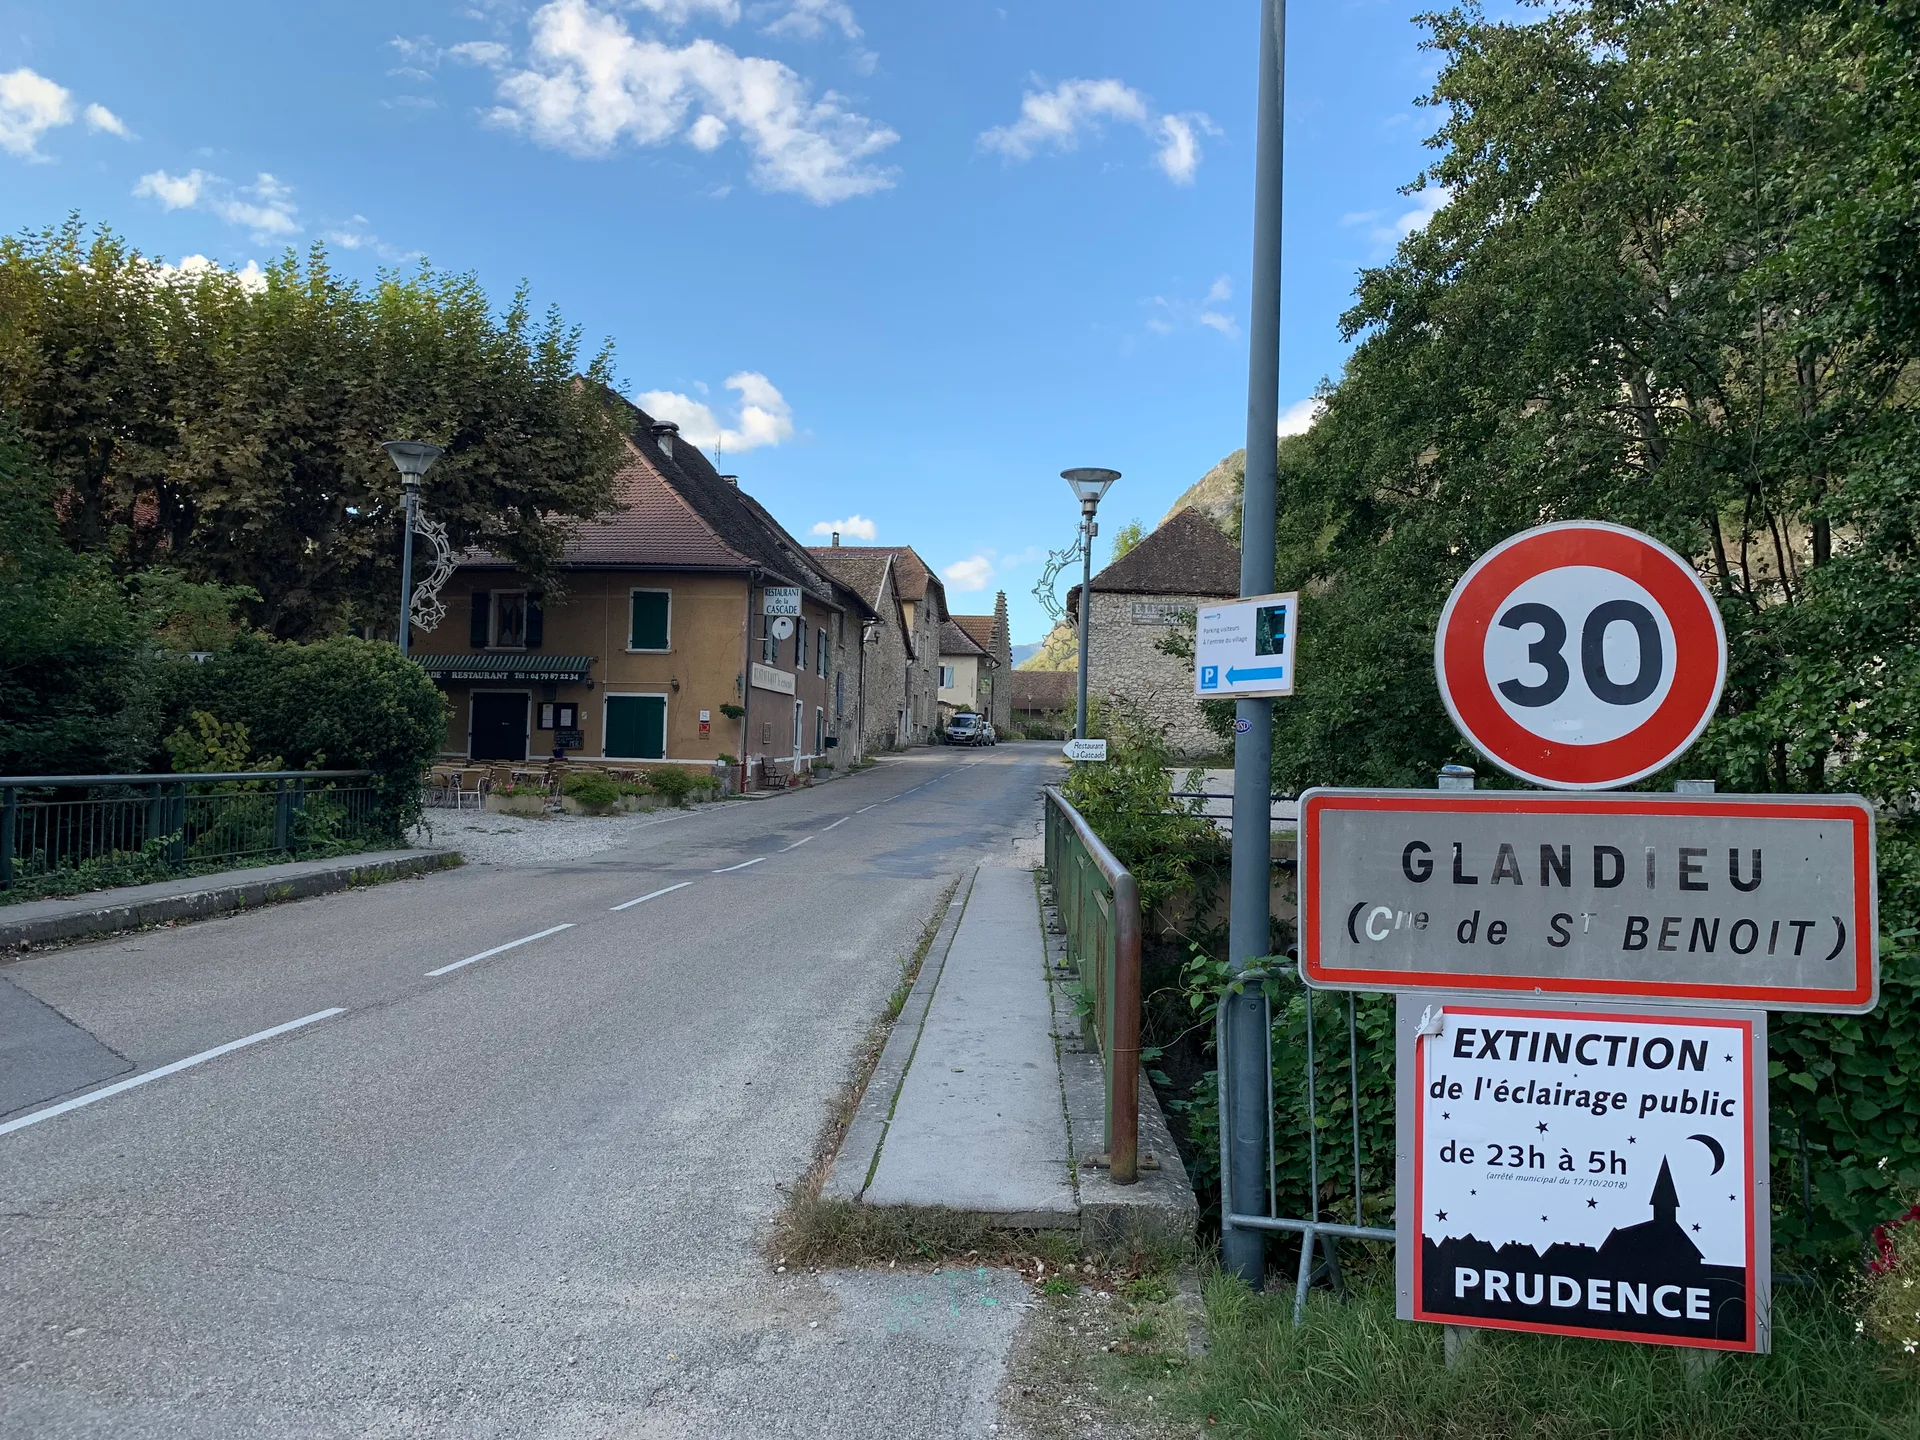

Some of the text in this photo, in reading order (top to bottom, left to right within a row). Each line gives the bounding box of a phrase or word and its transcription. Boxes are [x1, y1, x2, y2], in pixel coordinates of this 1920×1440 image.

[764, 588, 800, 597] RESTAURANT
[766, 605, 798, 614] CASCADE
[1497, 599, 1663, 707] 30
[451, 671, 509, 681] RESTAURANT
[569, 673, 579, 681] 34
[1205, 668, 1214, 683] P
[1073, 741, 1104, 750] Restaurant
[1401, 840, 1763, 892] GLANDIEU
[1457, 910, 1508, 945] de
[1453, 1027, 1708, 1072] EXTINCTION
[1429, 1075, 1736, 1119] de l'éclairage public
[1439, 1139, 1627, 1175] de 23h à 5h
[1486, 1172, 1628, 1190] (arrêté municipal du 17/10/2018)
[1455, 1266, 1710, 1321] PRUDENCE
